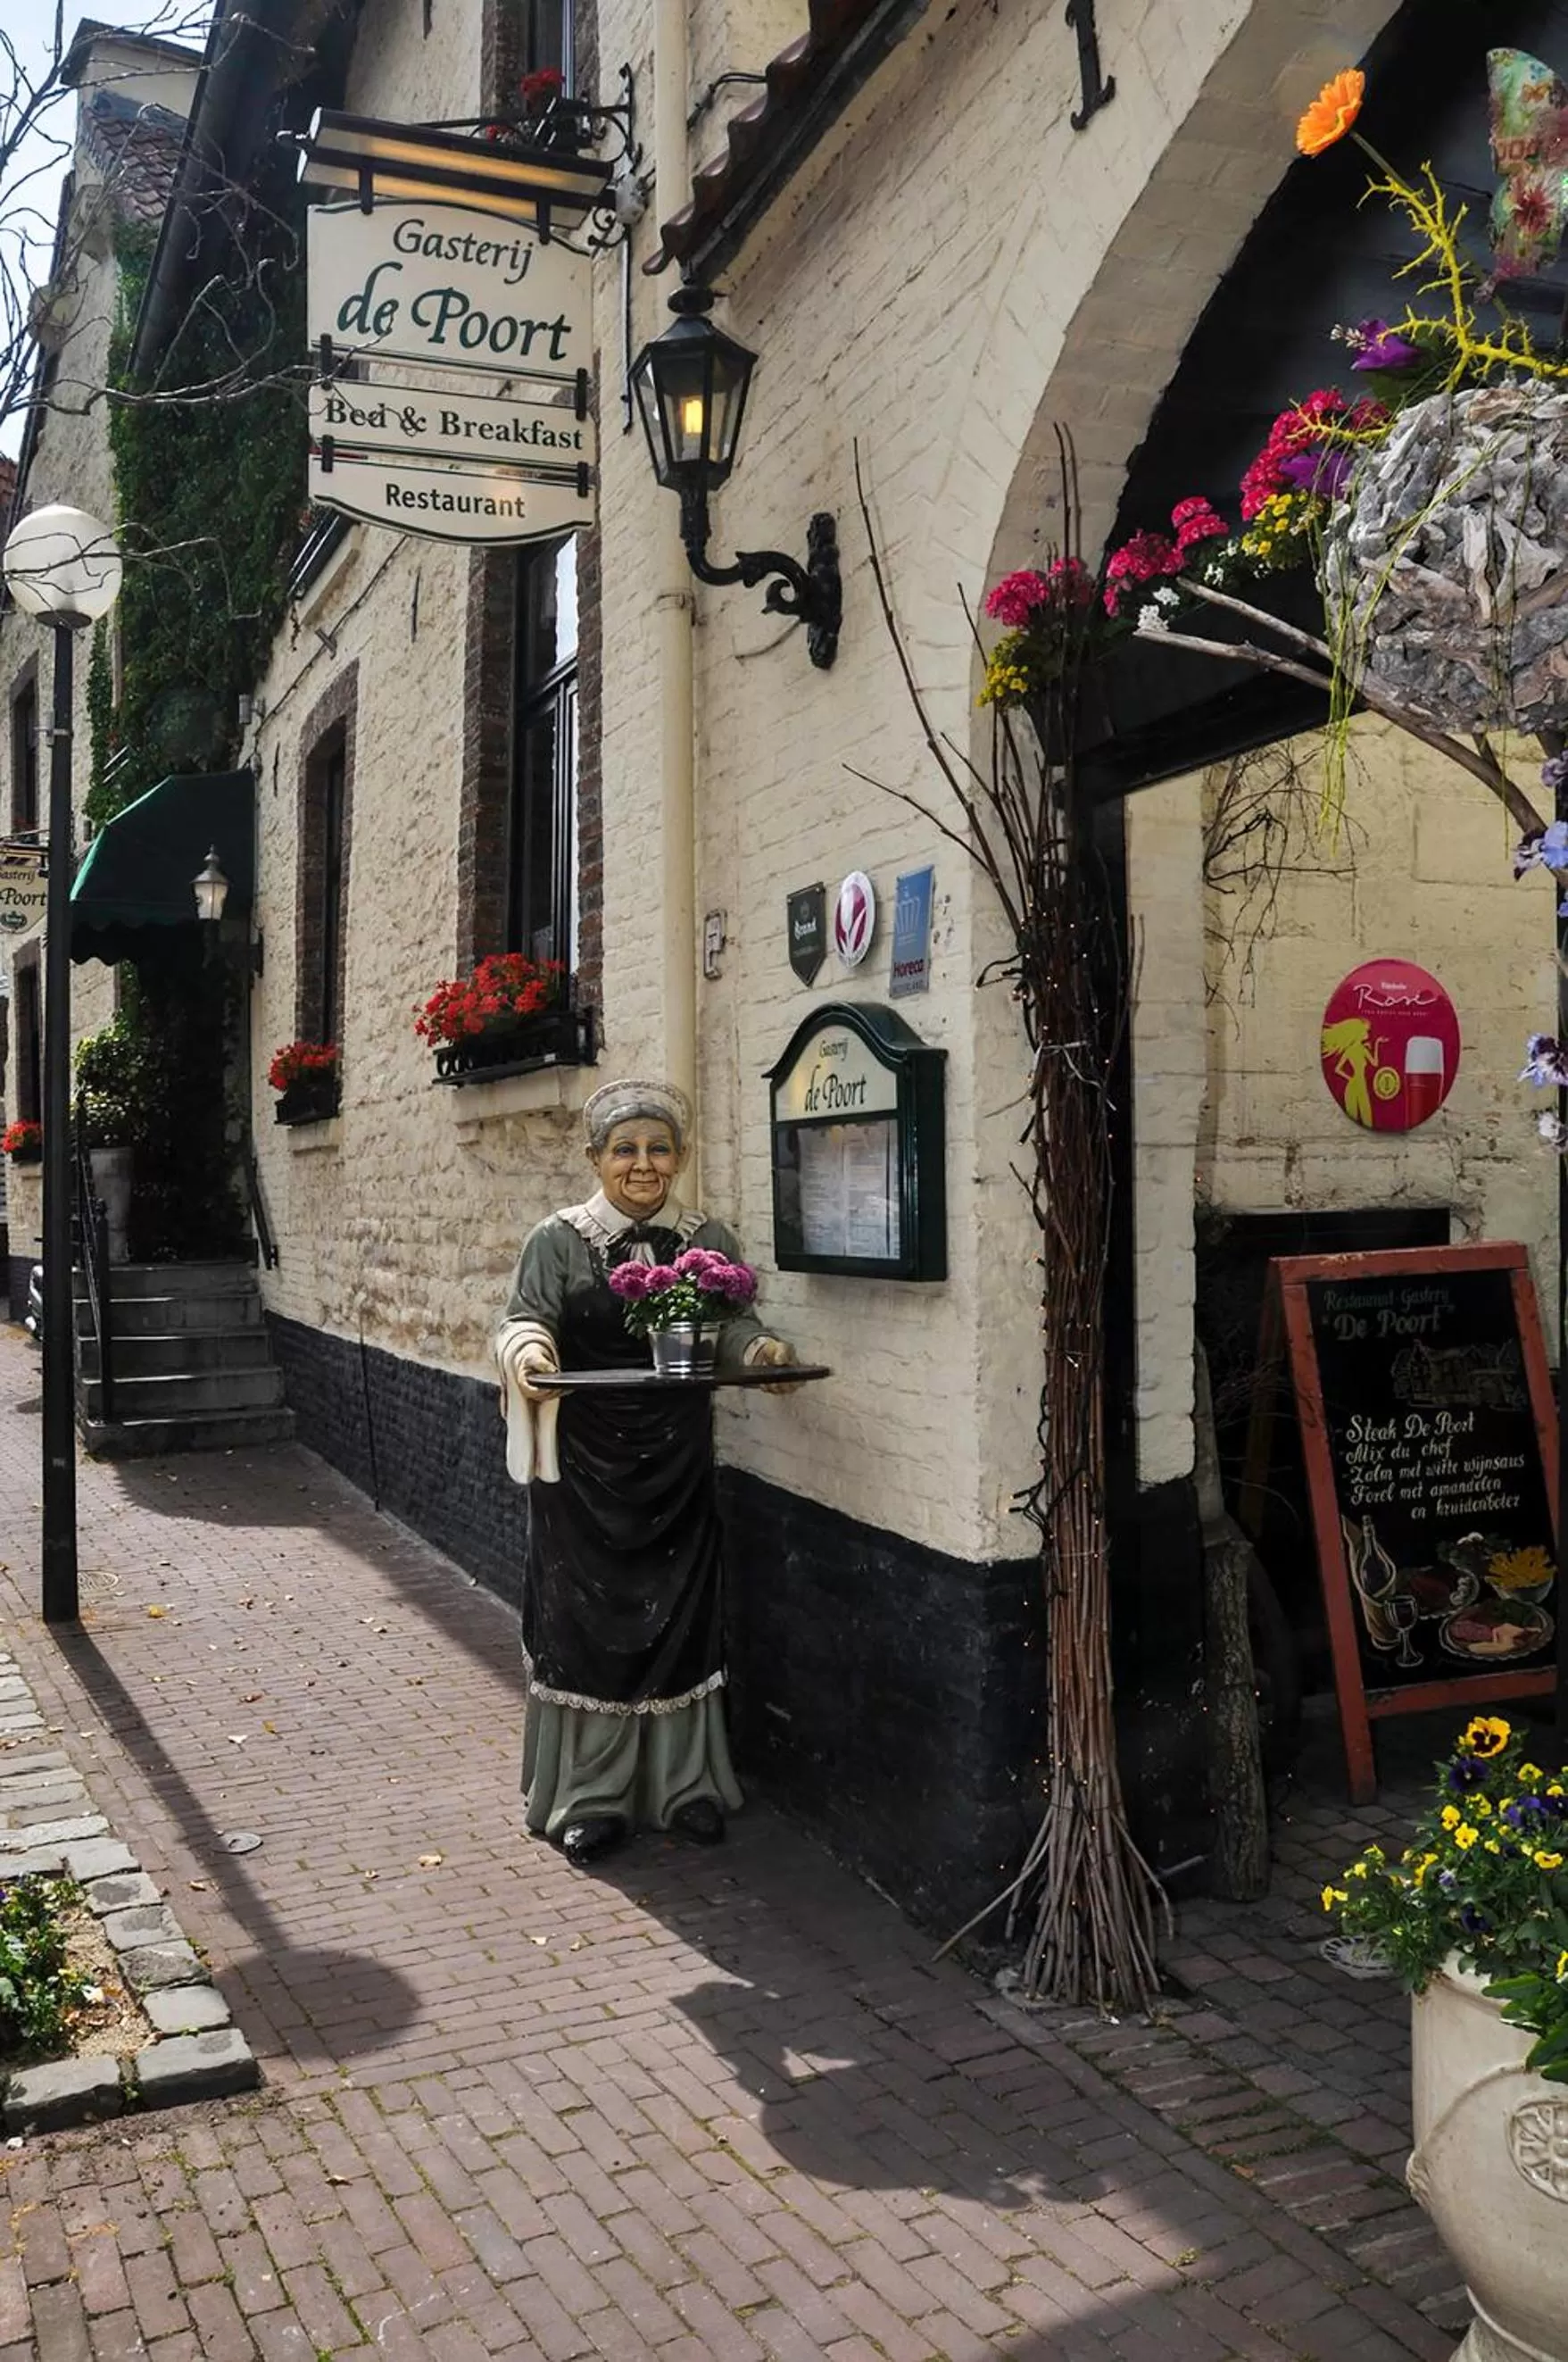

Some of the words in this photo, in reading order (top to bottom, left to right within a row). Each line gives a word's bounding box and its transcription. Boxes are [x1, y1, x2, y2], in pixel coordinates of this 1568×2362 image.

[393, 219, 535, 284] Gasterij
[336, 261, 404, 337] de
[411, 287, 572, 361] Poort
[324, 397, 386, 429] Bed
[399, 405, 427, 435] &
[439, 410, 584, 450] Breakfast
[386, 483, 526, 519] Restaurant
[0, 870, 36, 886] asterij
[0, 887, 47, 907] Poort
[805, 1065, 821, 1112] de
[823, 1073, 867, 1109] Poort
[1346, 1414, 1397, 1443] Steak
[1403, 1413, 1431, 1439] De
[1433, 1410, 1474, 1436] Poort
[1390, 1440, 1410, 1460] du
[1421, 1435, 1454, 1458] chef
[1398, 1460, 1422, 1478] met
[1463, 1453, 1525, 1479] wijnsaus
[1399, 1481, 1423, 1500] met
[1430, 1475, 1502, 1498] amandelen
[1410, 1505, 1427, 1519] en
